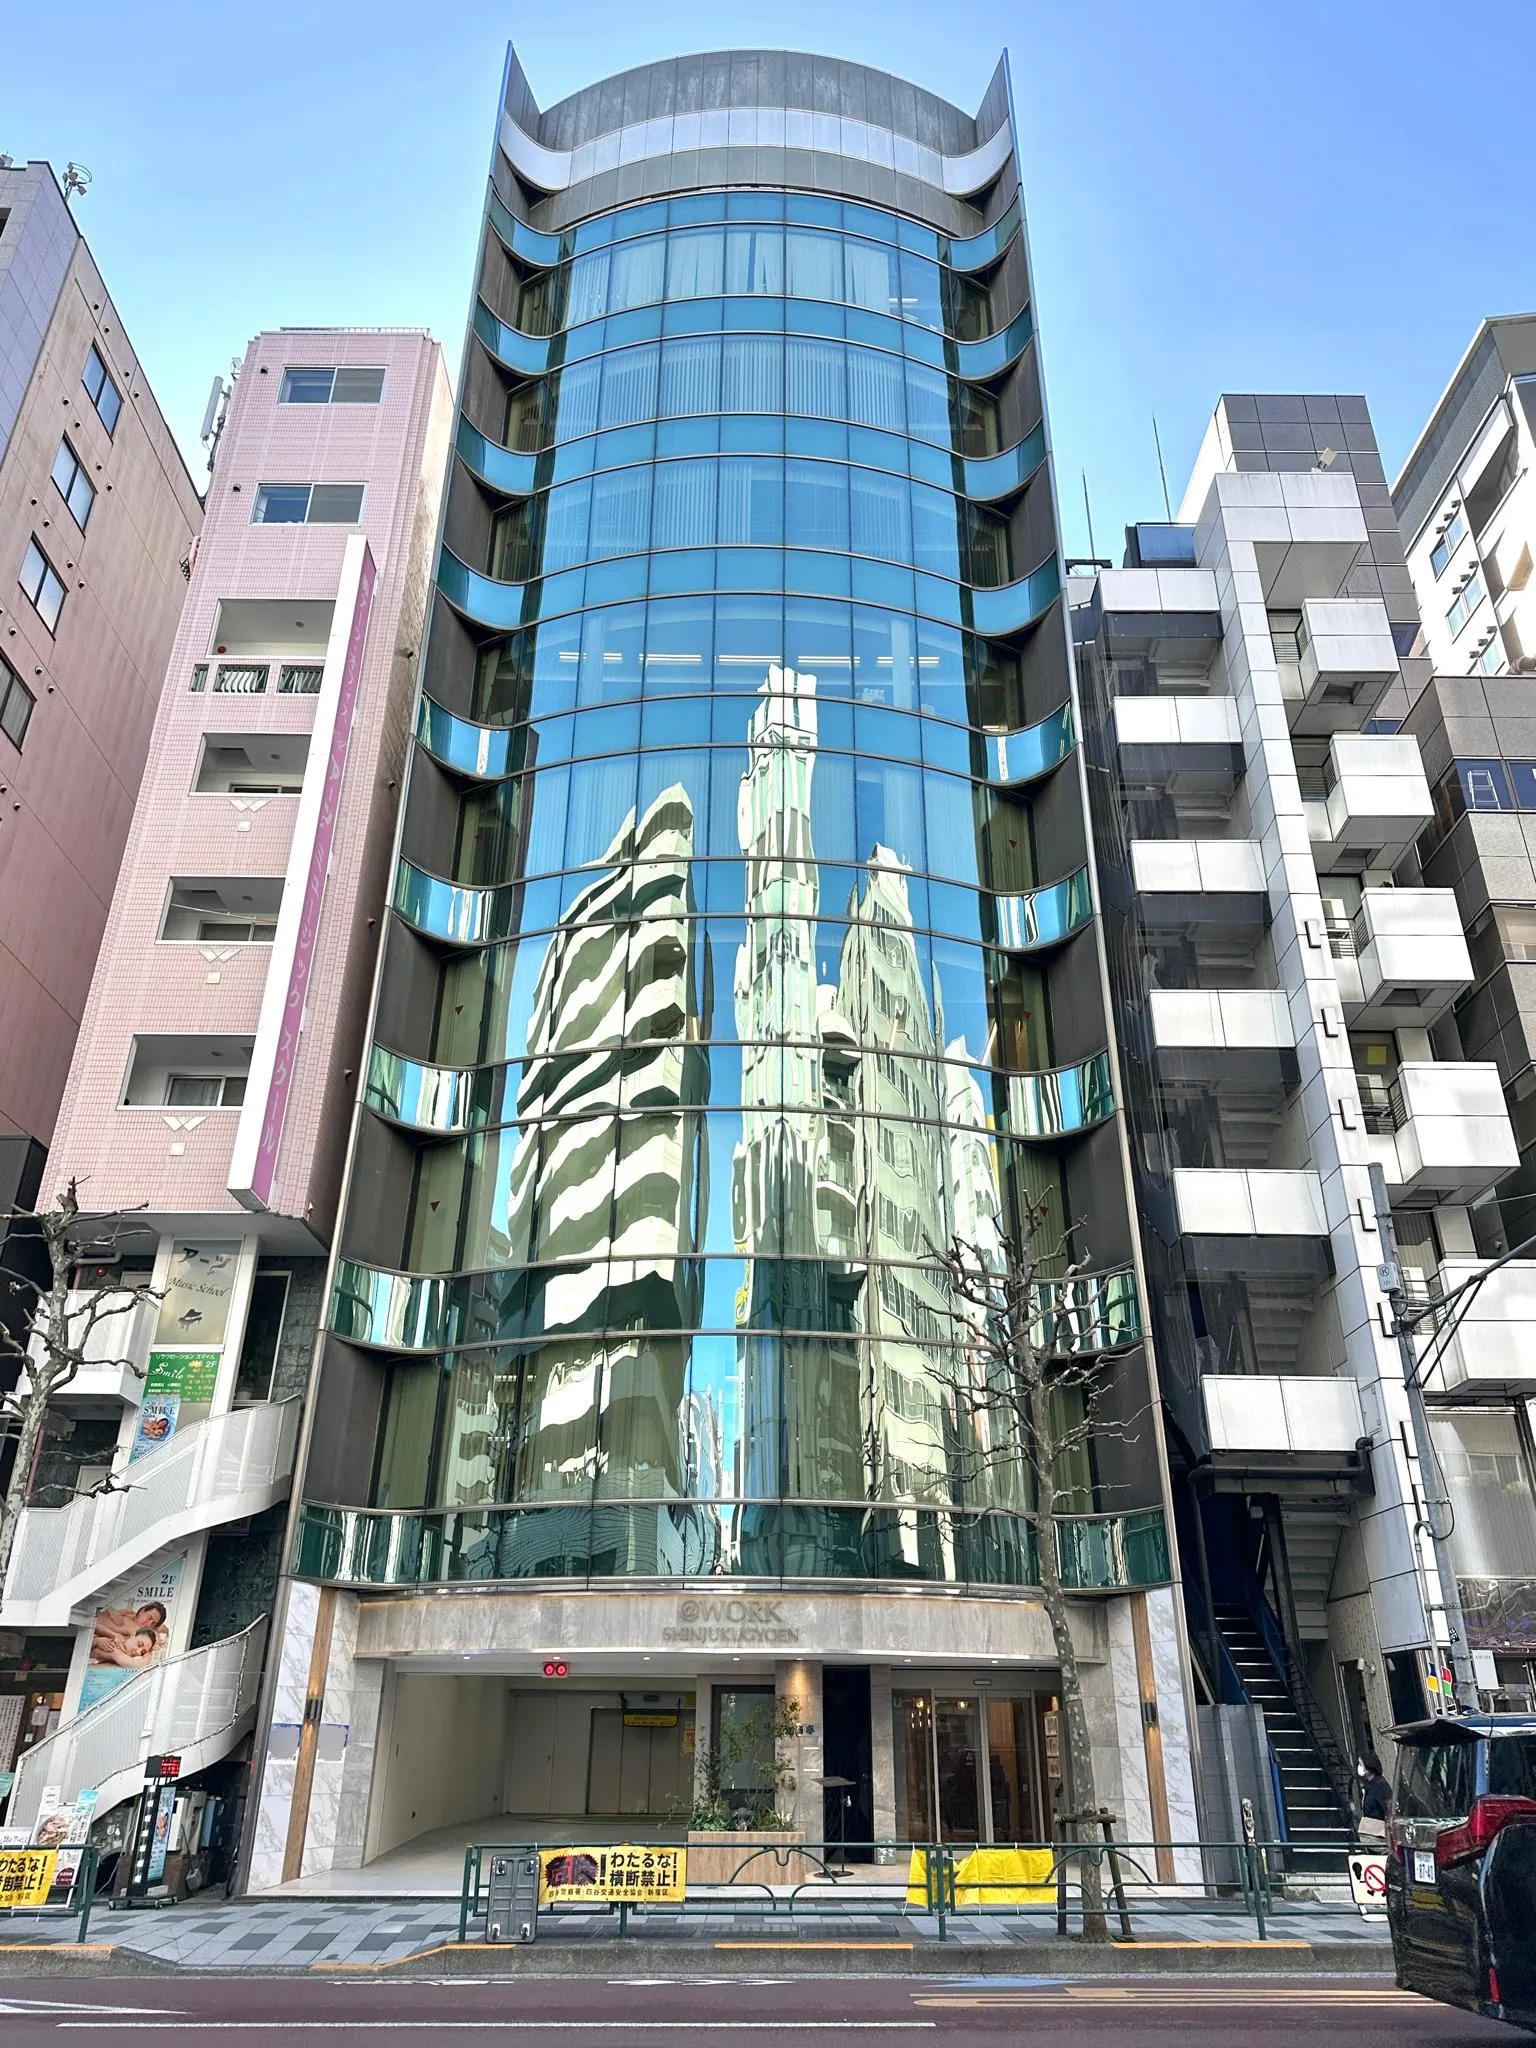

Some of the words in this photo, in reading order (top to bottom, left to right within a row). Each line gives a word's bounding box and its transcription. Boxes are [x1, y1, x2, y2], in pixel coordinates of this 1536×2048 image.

[177, 1247, 232, 1276] アーツ
[168, 1277, 196, 1291] Music
[196, 1283, 232, 1296] School
[152, 1362, 186, 1379] Smile
[161, 1573, 176, 1584] 2F
[137, 1587, 175, 1597] SMILE
[680, 1600, 784, 1623] @WORK
[663, 1627, 799, 1643] SHINJUKUGYOEN
[610, 1852, 678, 1868] わたるな!
[609, 1869, 678, 1888] 横断禁止!
